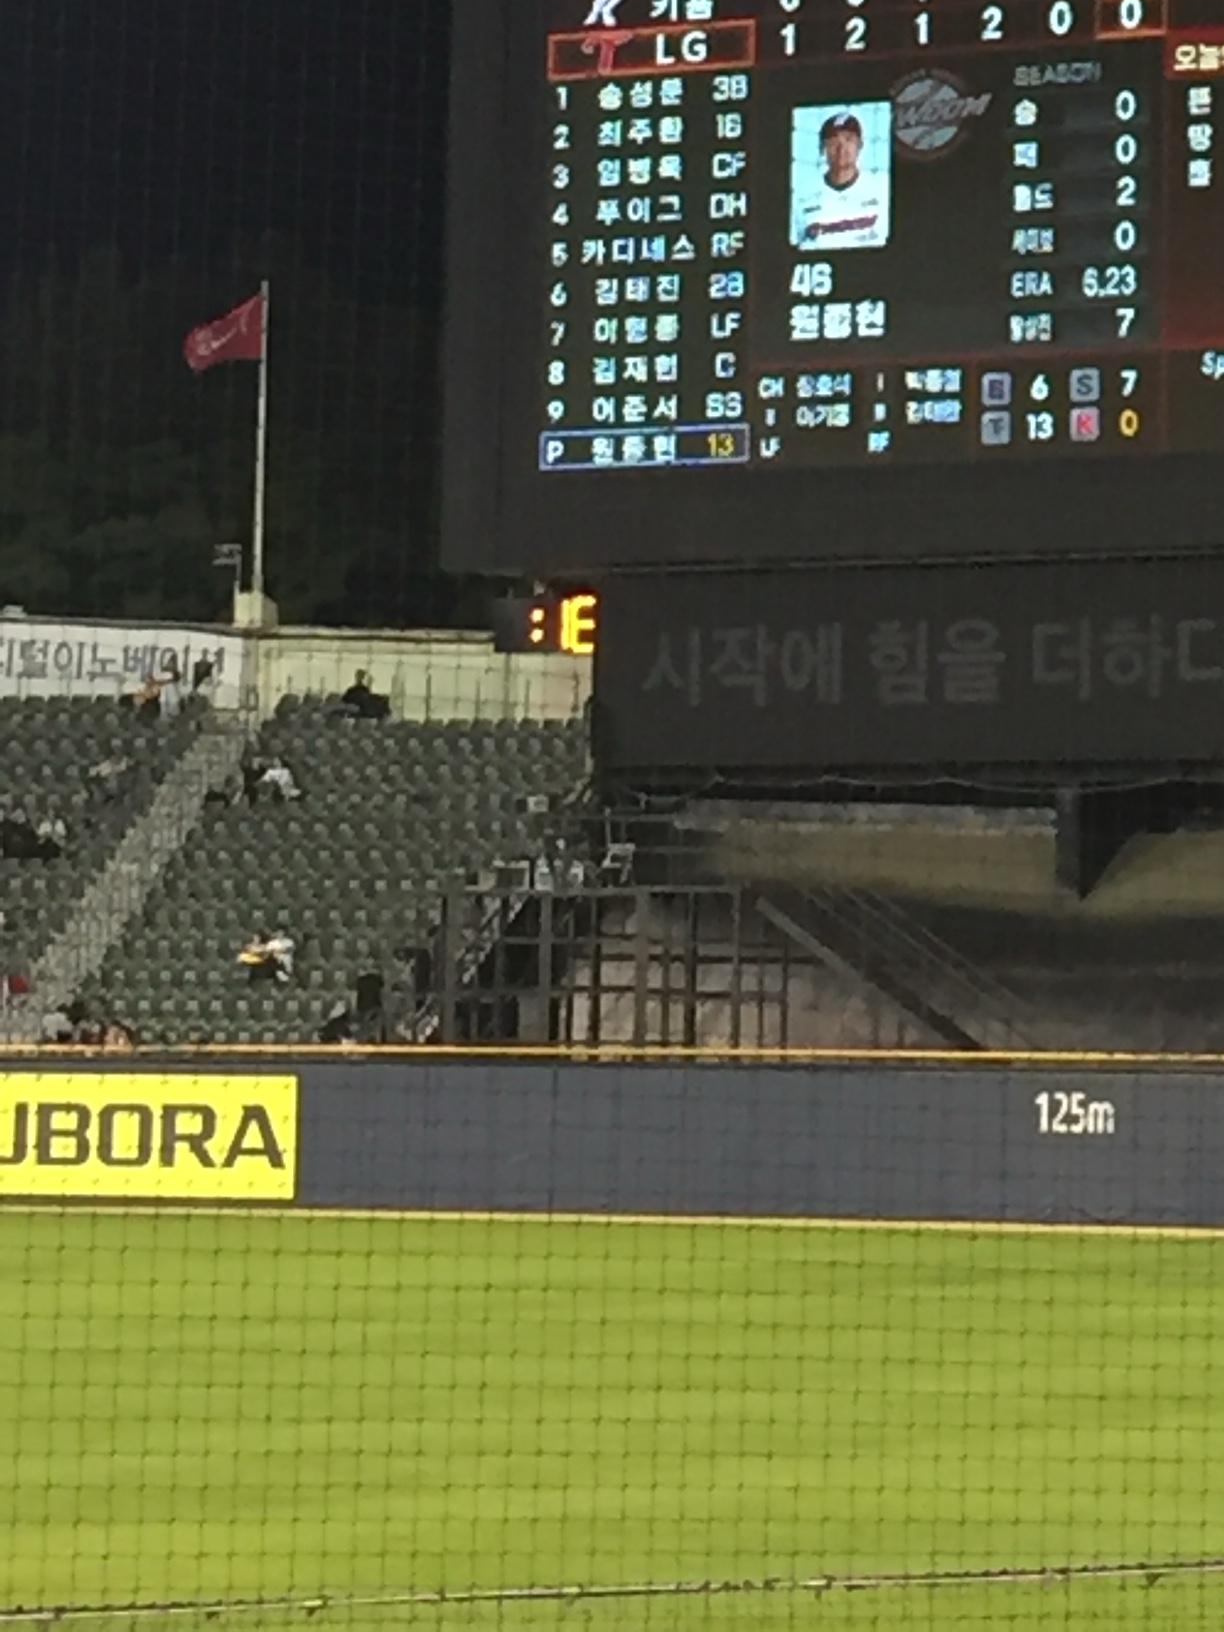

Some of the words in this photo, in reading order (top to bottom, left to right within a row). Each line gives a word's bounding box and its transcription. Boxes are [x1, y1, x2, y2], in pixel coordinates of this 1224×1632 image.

[655, 30, 707, 66] LG
[780, 23, 795, 56] 1
[845, 16, 866, 51] 2
[915, 12, 928, 45] 1
[981, 6, 1003, 41] 2
[1049, 0, 1073, 35] 0
[556, 86, 567, 110] 1
[597, 77, 683, 111] 송성문
[712, 74, 748, 102] 3B
[1115, 90, 1137, 121] 0
[553, 124, 570, 150] 2
[1115, 134, 1137, 165] 0
[552, 164, 569, 189] 3
[712, 151, 746, 179] CF
[1116, 175, 1136, 207] 2
[551, 203, 569, 226] 4
[595, 195, 682, 226] 푸이그
[709, 192, 747, 219] DH
[551, 242, 569, 267] 5
[581, 234, 695, 266] 카디네스
[710, 231, 745, 258] RF
[1114, 220, 1136, 251] 0
[550, 282, 567, 307] 6
[594, 274, 680, 306] 김태진
[708, 272, 744, 299] 2B
[789, 263, 832, 297] 46
[1010, 271, 1053, 298] ERA
[1082, 264, 1137, 298] 6.23
[550, 321, 565, 346] 7
[710, 312, 741, 339] LF
[1116, 307, 1135, 338] 7
[548, 360, 565, 386] 8
[715, 352, 736, 378] C
[1030, 374, 1049, 401] 6
[1120, 369, 1137, 397] 7
[546, 400, 565, 422] 9
[592, 394, 678, 423] 어준서
[705, 391, 742, 419] SS
[1026, 411, 1054, 440] 13
[1119, 408, 1138, 437] 0
[545, 440, 565, 464] P
[707, 433, 735, 460] 13
[642, 622, 842, 706] 시작에
[868, 616, 1006, 704] 힘을
[1034, 1090, 1116, 1135] 125m
